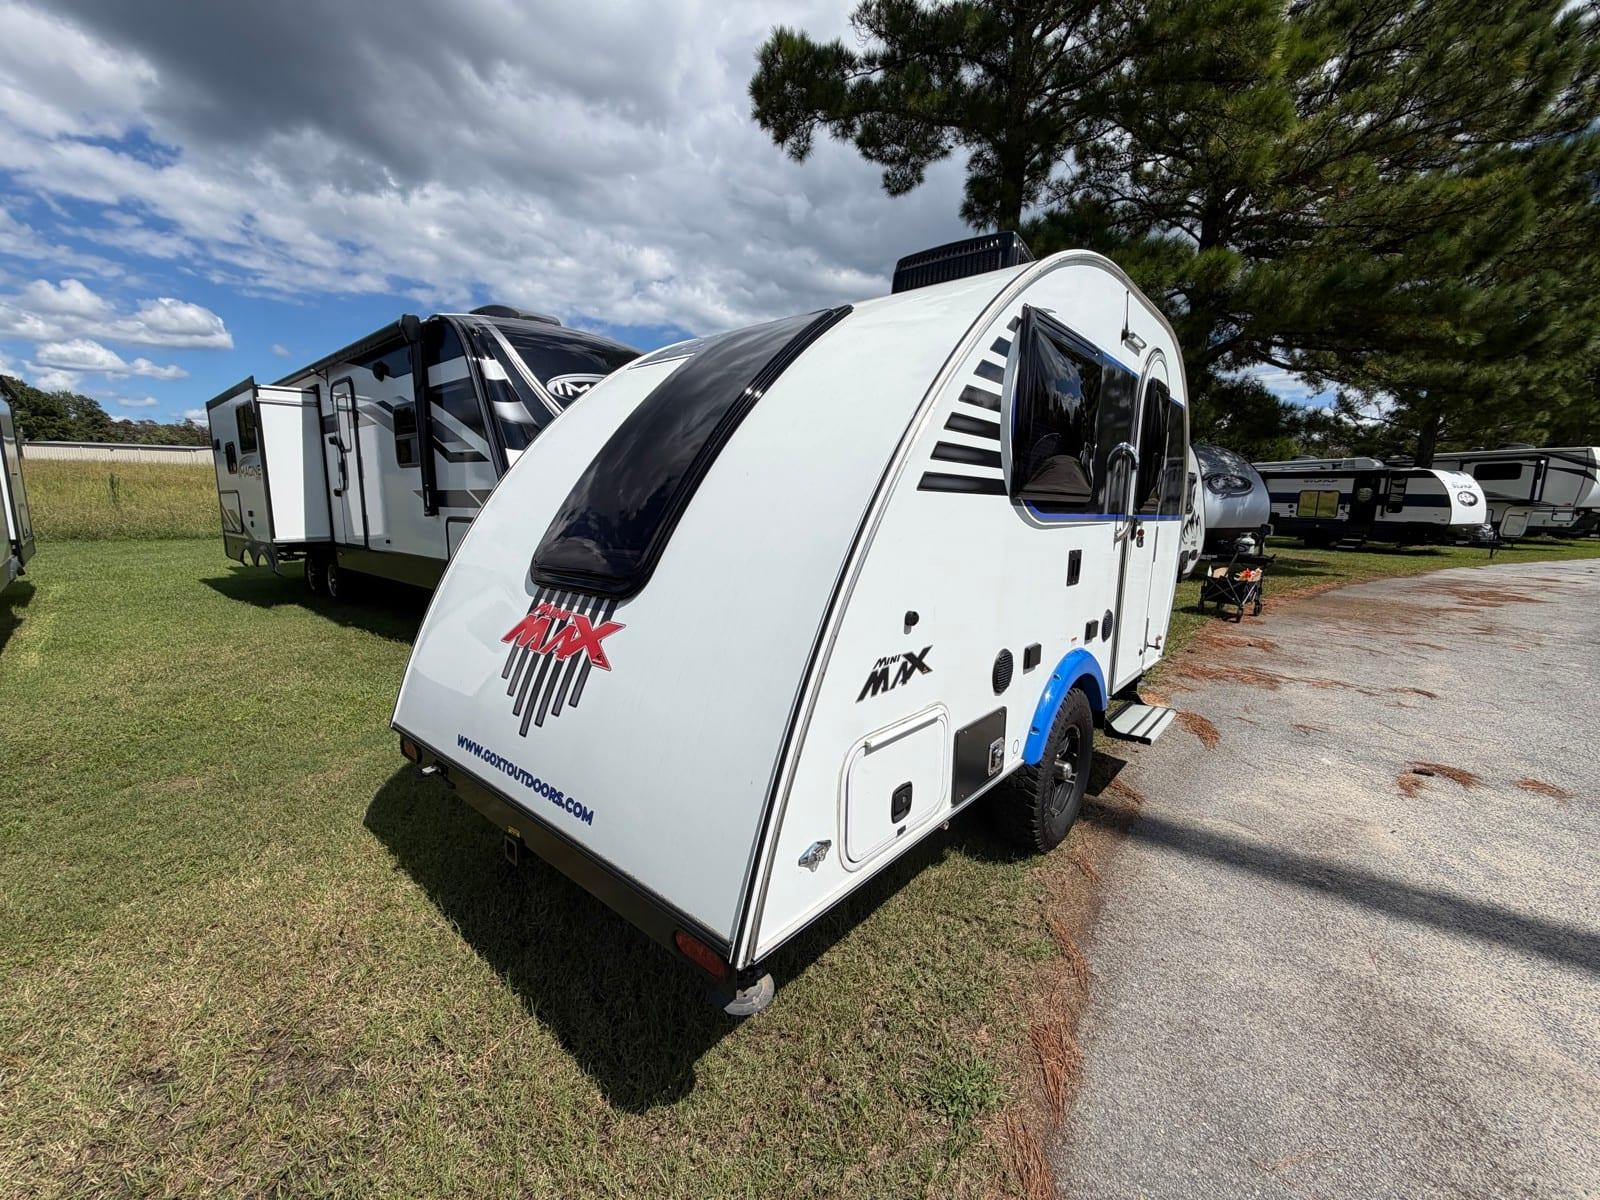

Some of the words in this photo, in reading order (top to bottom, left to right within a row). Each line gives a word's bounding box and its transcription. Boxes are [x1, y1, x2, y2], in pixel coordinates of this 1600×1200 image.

[500, 613, 627, 671] MAX
[873, 654, 901, 670] MINI
[855, 644, 933, 703] MAX
[457, 733, 594, 826] WWW.GOXTOUTDOORS.COM
